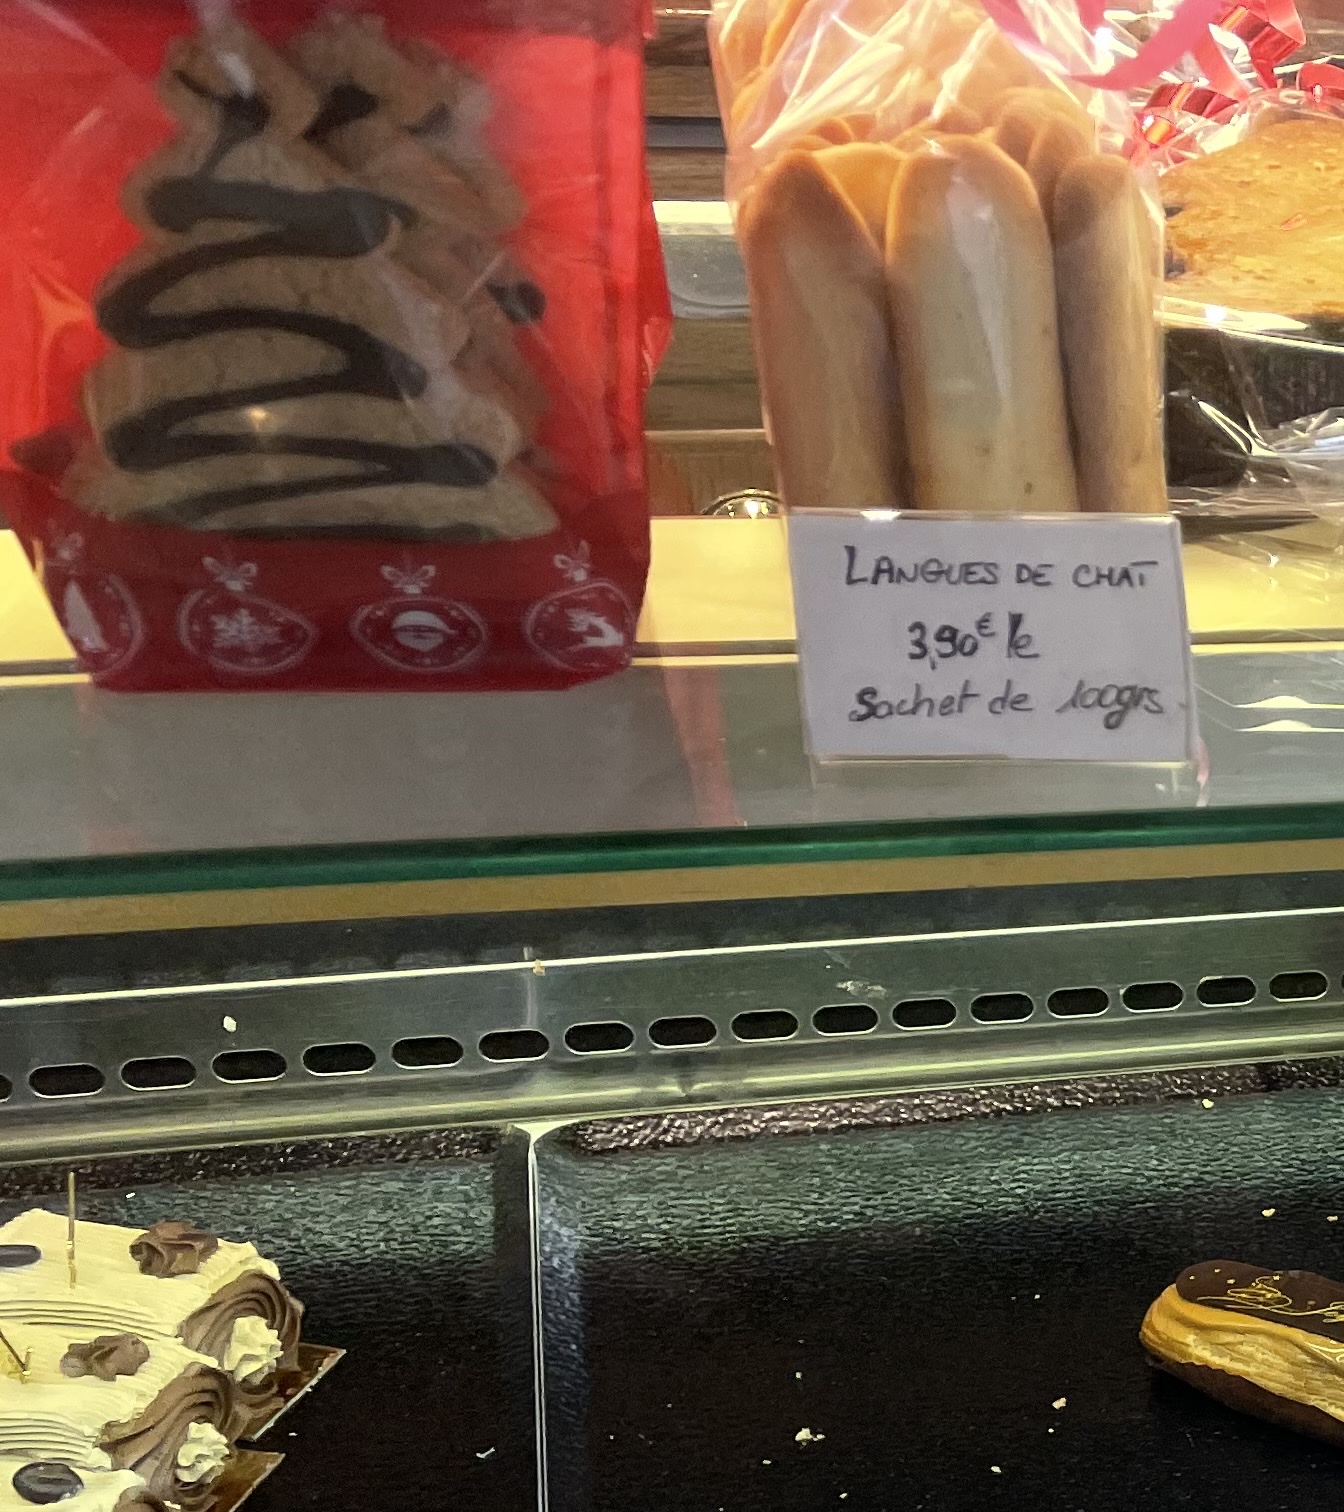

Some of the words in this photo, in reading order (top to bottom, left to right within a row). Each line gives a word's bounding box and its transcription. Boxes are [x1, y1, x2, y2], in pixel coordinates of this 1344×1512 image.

[845, 545, 999, 587] LANGUES
[1015, 562, 1053, 586] DE
[1073, 560, 1158, 588] CHAT
[1007, 612, 1040, 660] le
[849, 679, 983, 722] Sachet
[987, 679, 1034, 714] de
